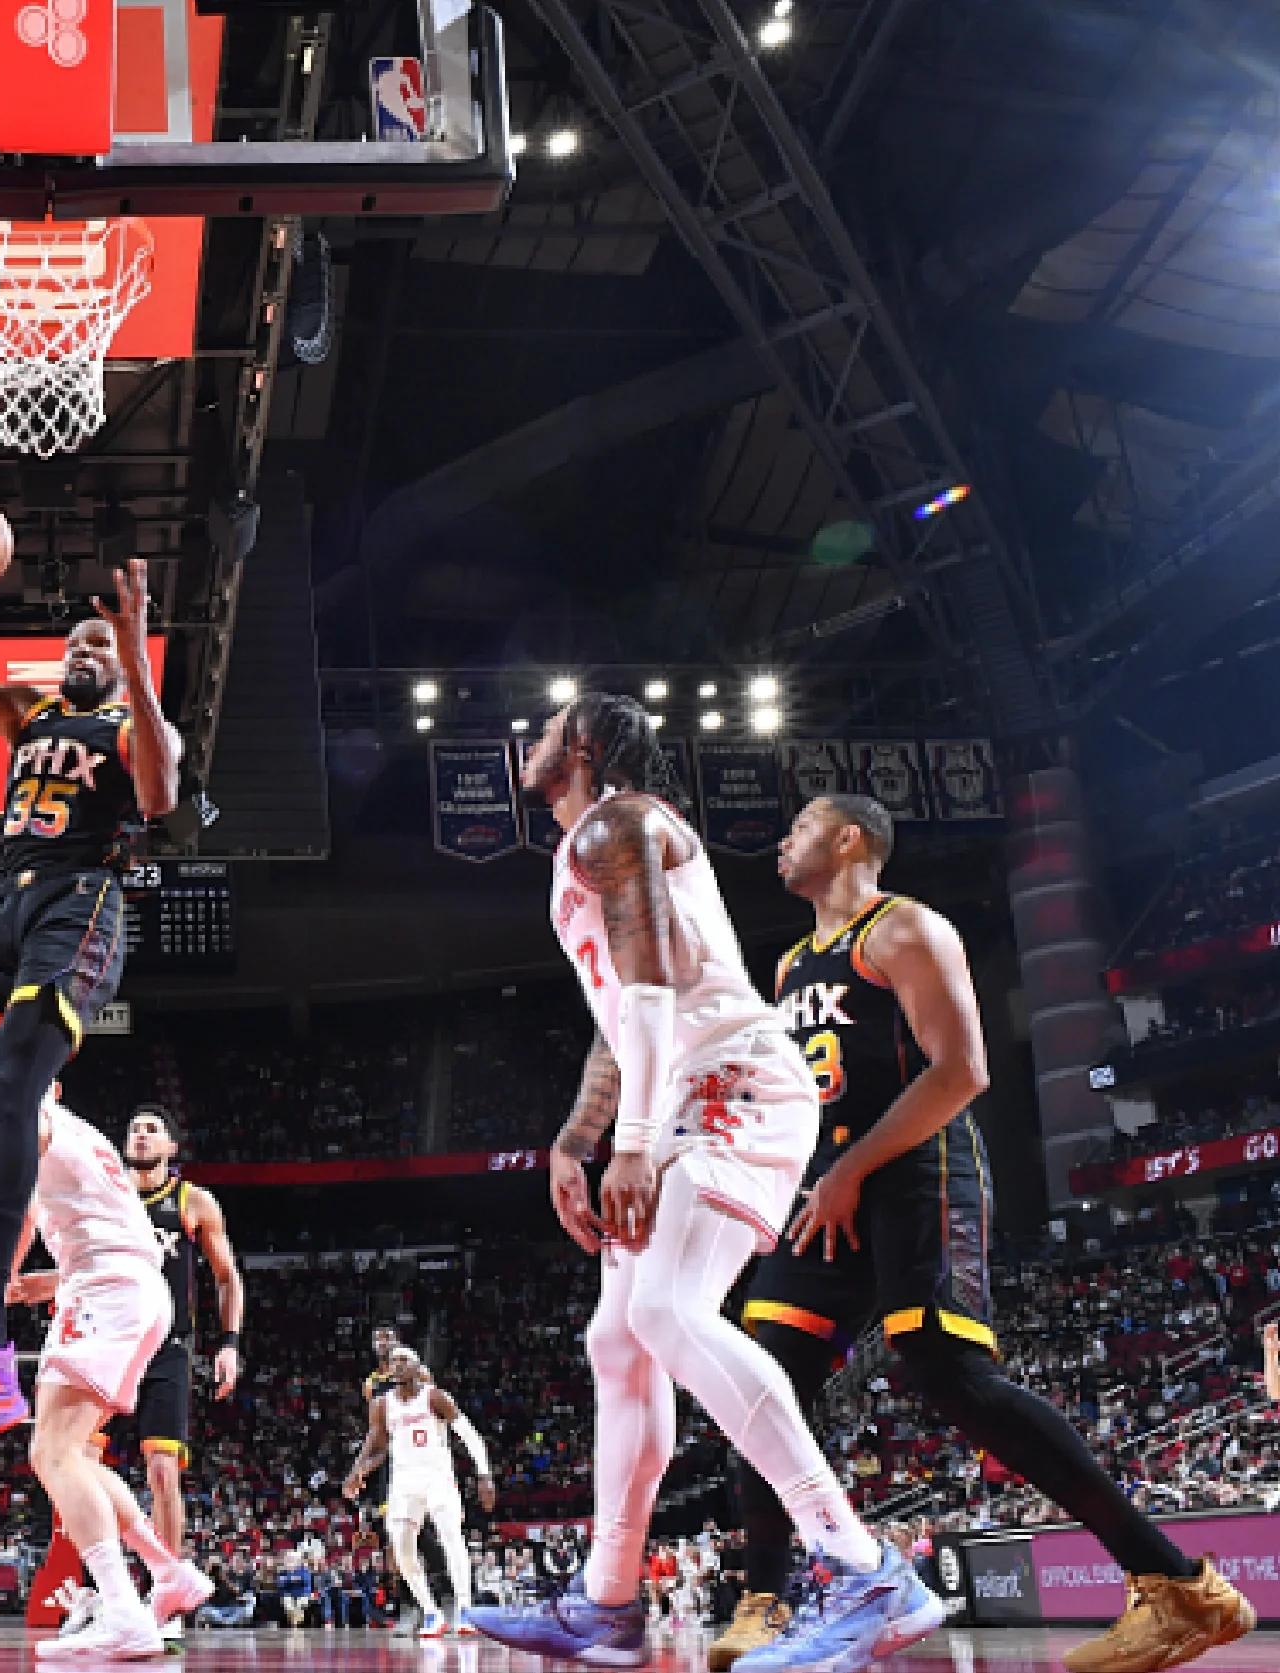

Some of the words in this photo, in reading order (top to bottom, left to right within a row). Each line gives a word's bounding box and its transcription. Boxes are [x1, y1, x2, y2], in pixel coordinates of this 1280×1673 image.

[13, 736, 107, 790] PHX
[3, 778, 80, 837] 35
[576, 937, 604, 989] 7
[412, 1429, 428, 1447] 0
